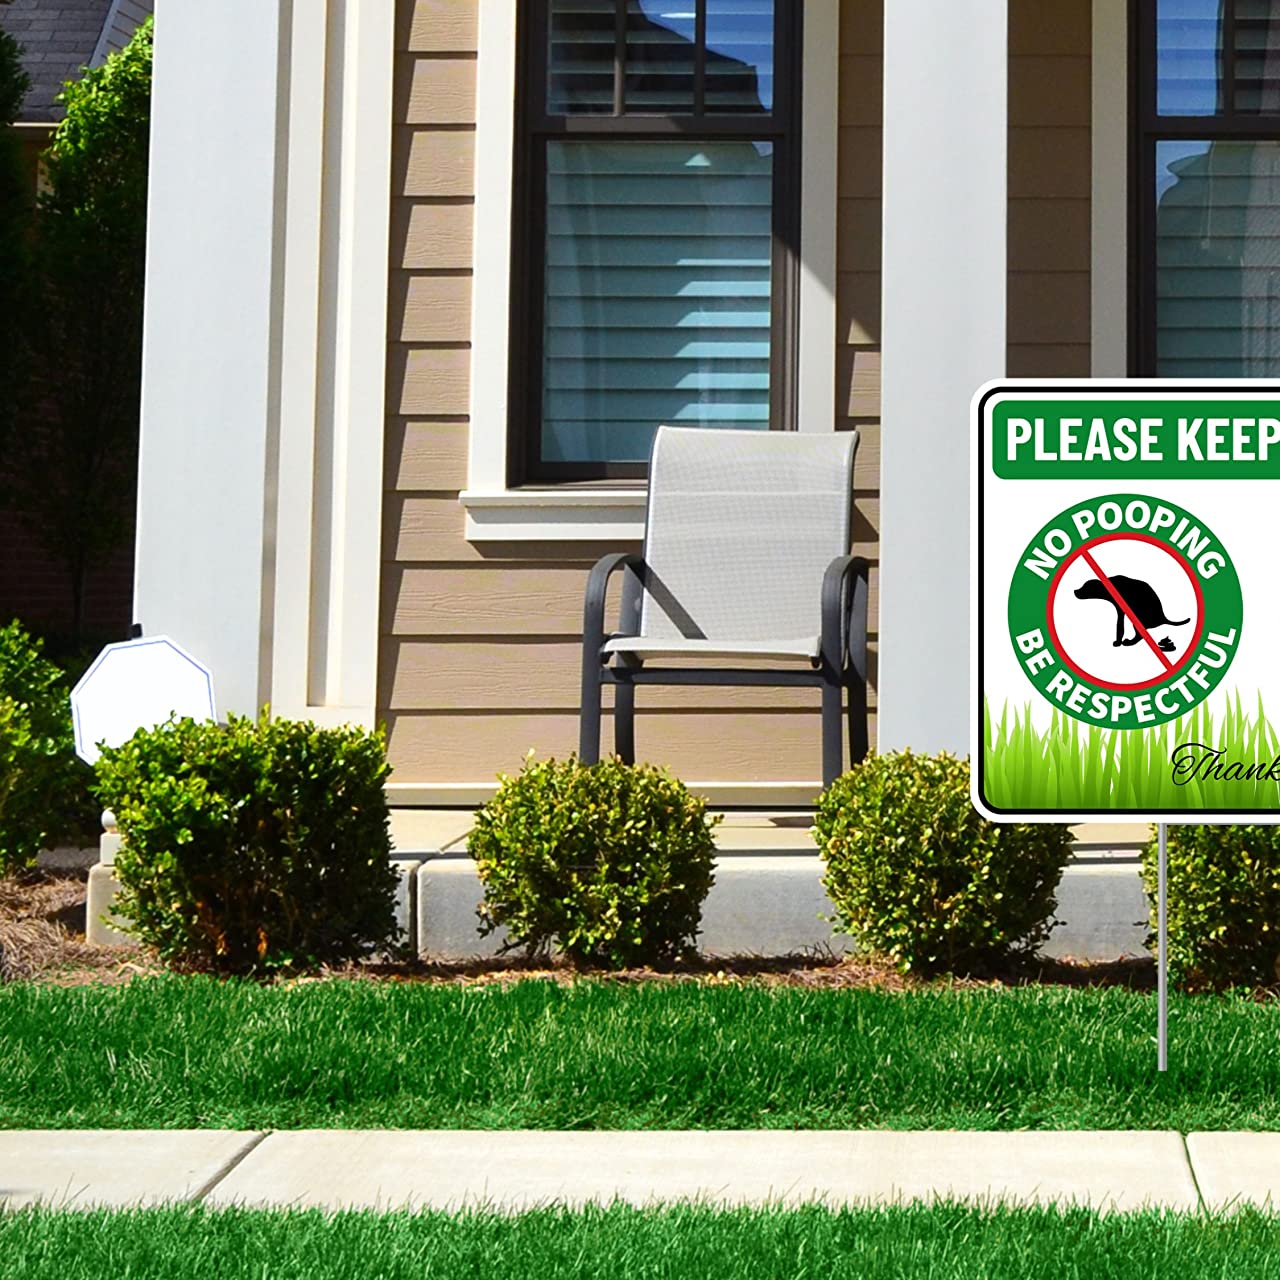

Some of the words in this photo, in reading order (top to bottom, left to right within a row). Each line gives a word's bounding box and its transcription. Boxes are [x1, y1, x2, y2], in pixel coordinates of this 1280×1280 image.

[1006, 417, 1163, 461] PLEASE
[1024, 529, 1073, 580] NO
[1072, 500, 1226, 580] POOPING
[1015, 628, 1055, 676] BE
[1045, 625, 1237, 723] RESPECTFUL
